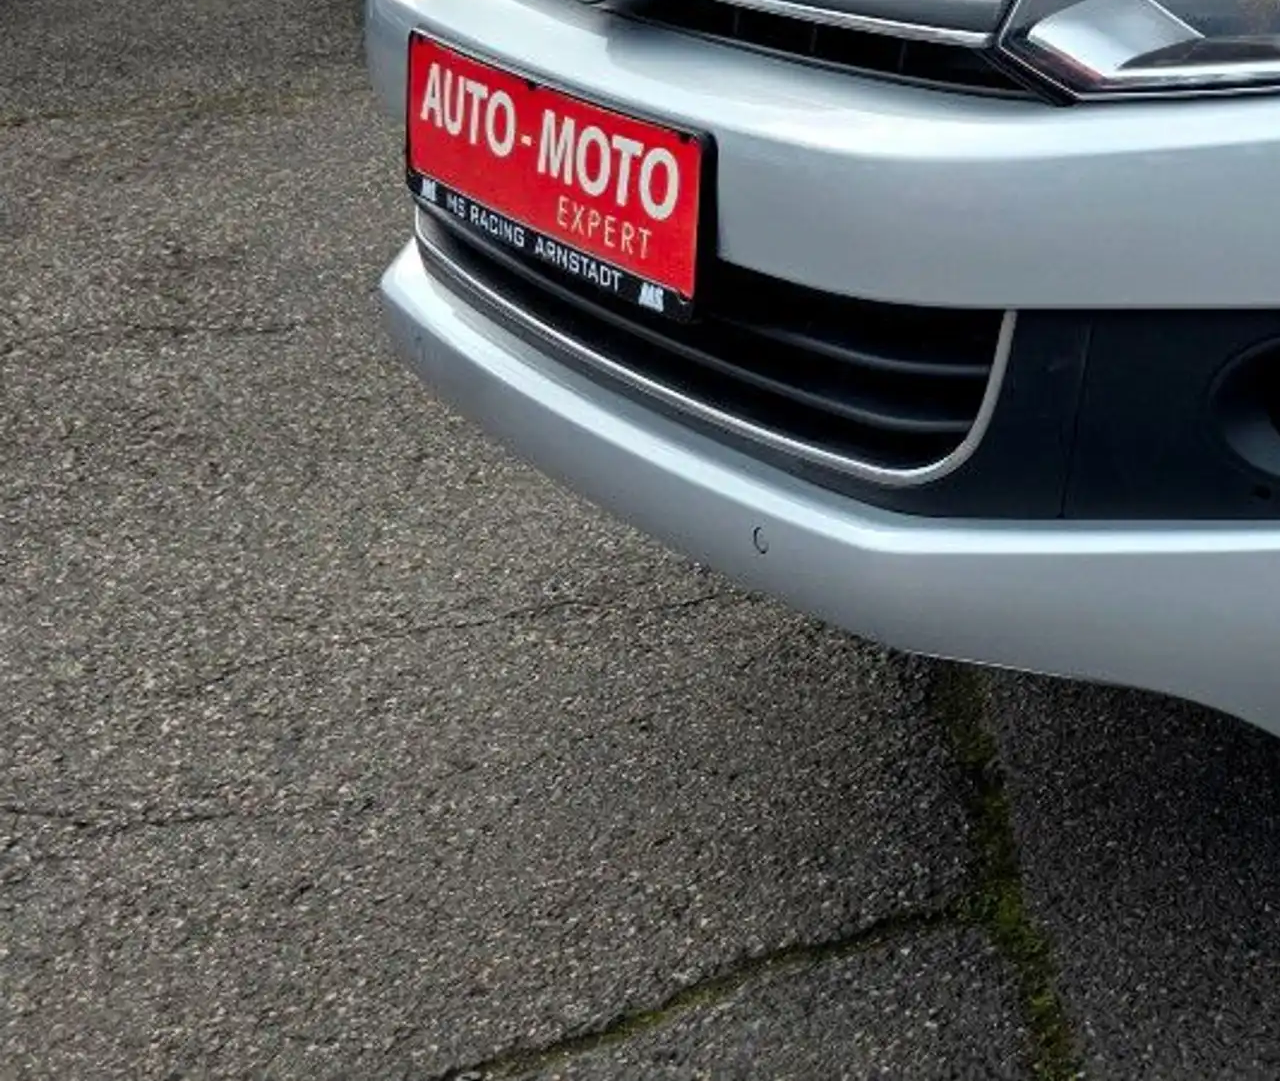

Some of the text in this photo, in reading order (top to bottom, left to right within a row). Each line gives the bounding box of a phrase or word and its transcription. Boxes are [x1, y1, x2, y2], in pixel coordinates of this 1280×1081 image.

[470, 204, 525, 248] RACING
[534, 236, 623, 292] ARNSTADT
[556, 195, 652, 259] EXPERT
